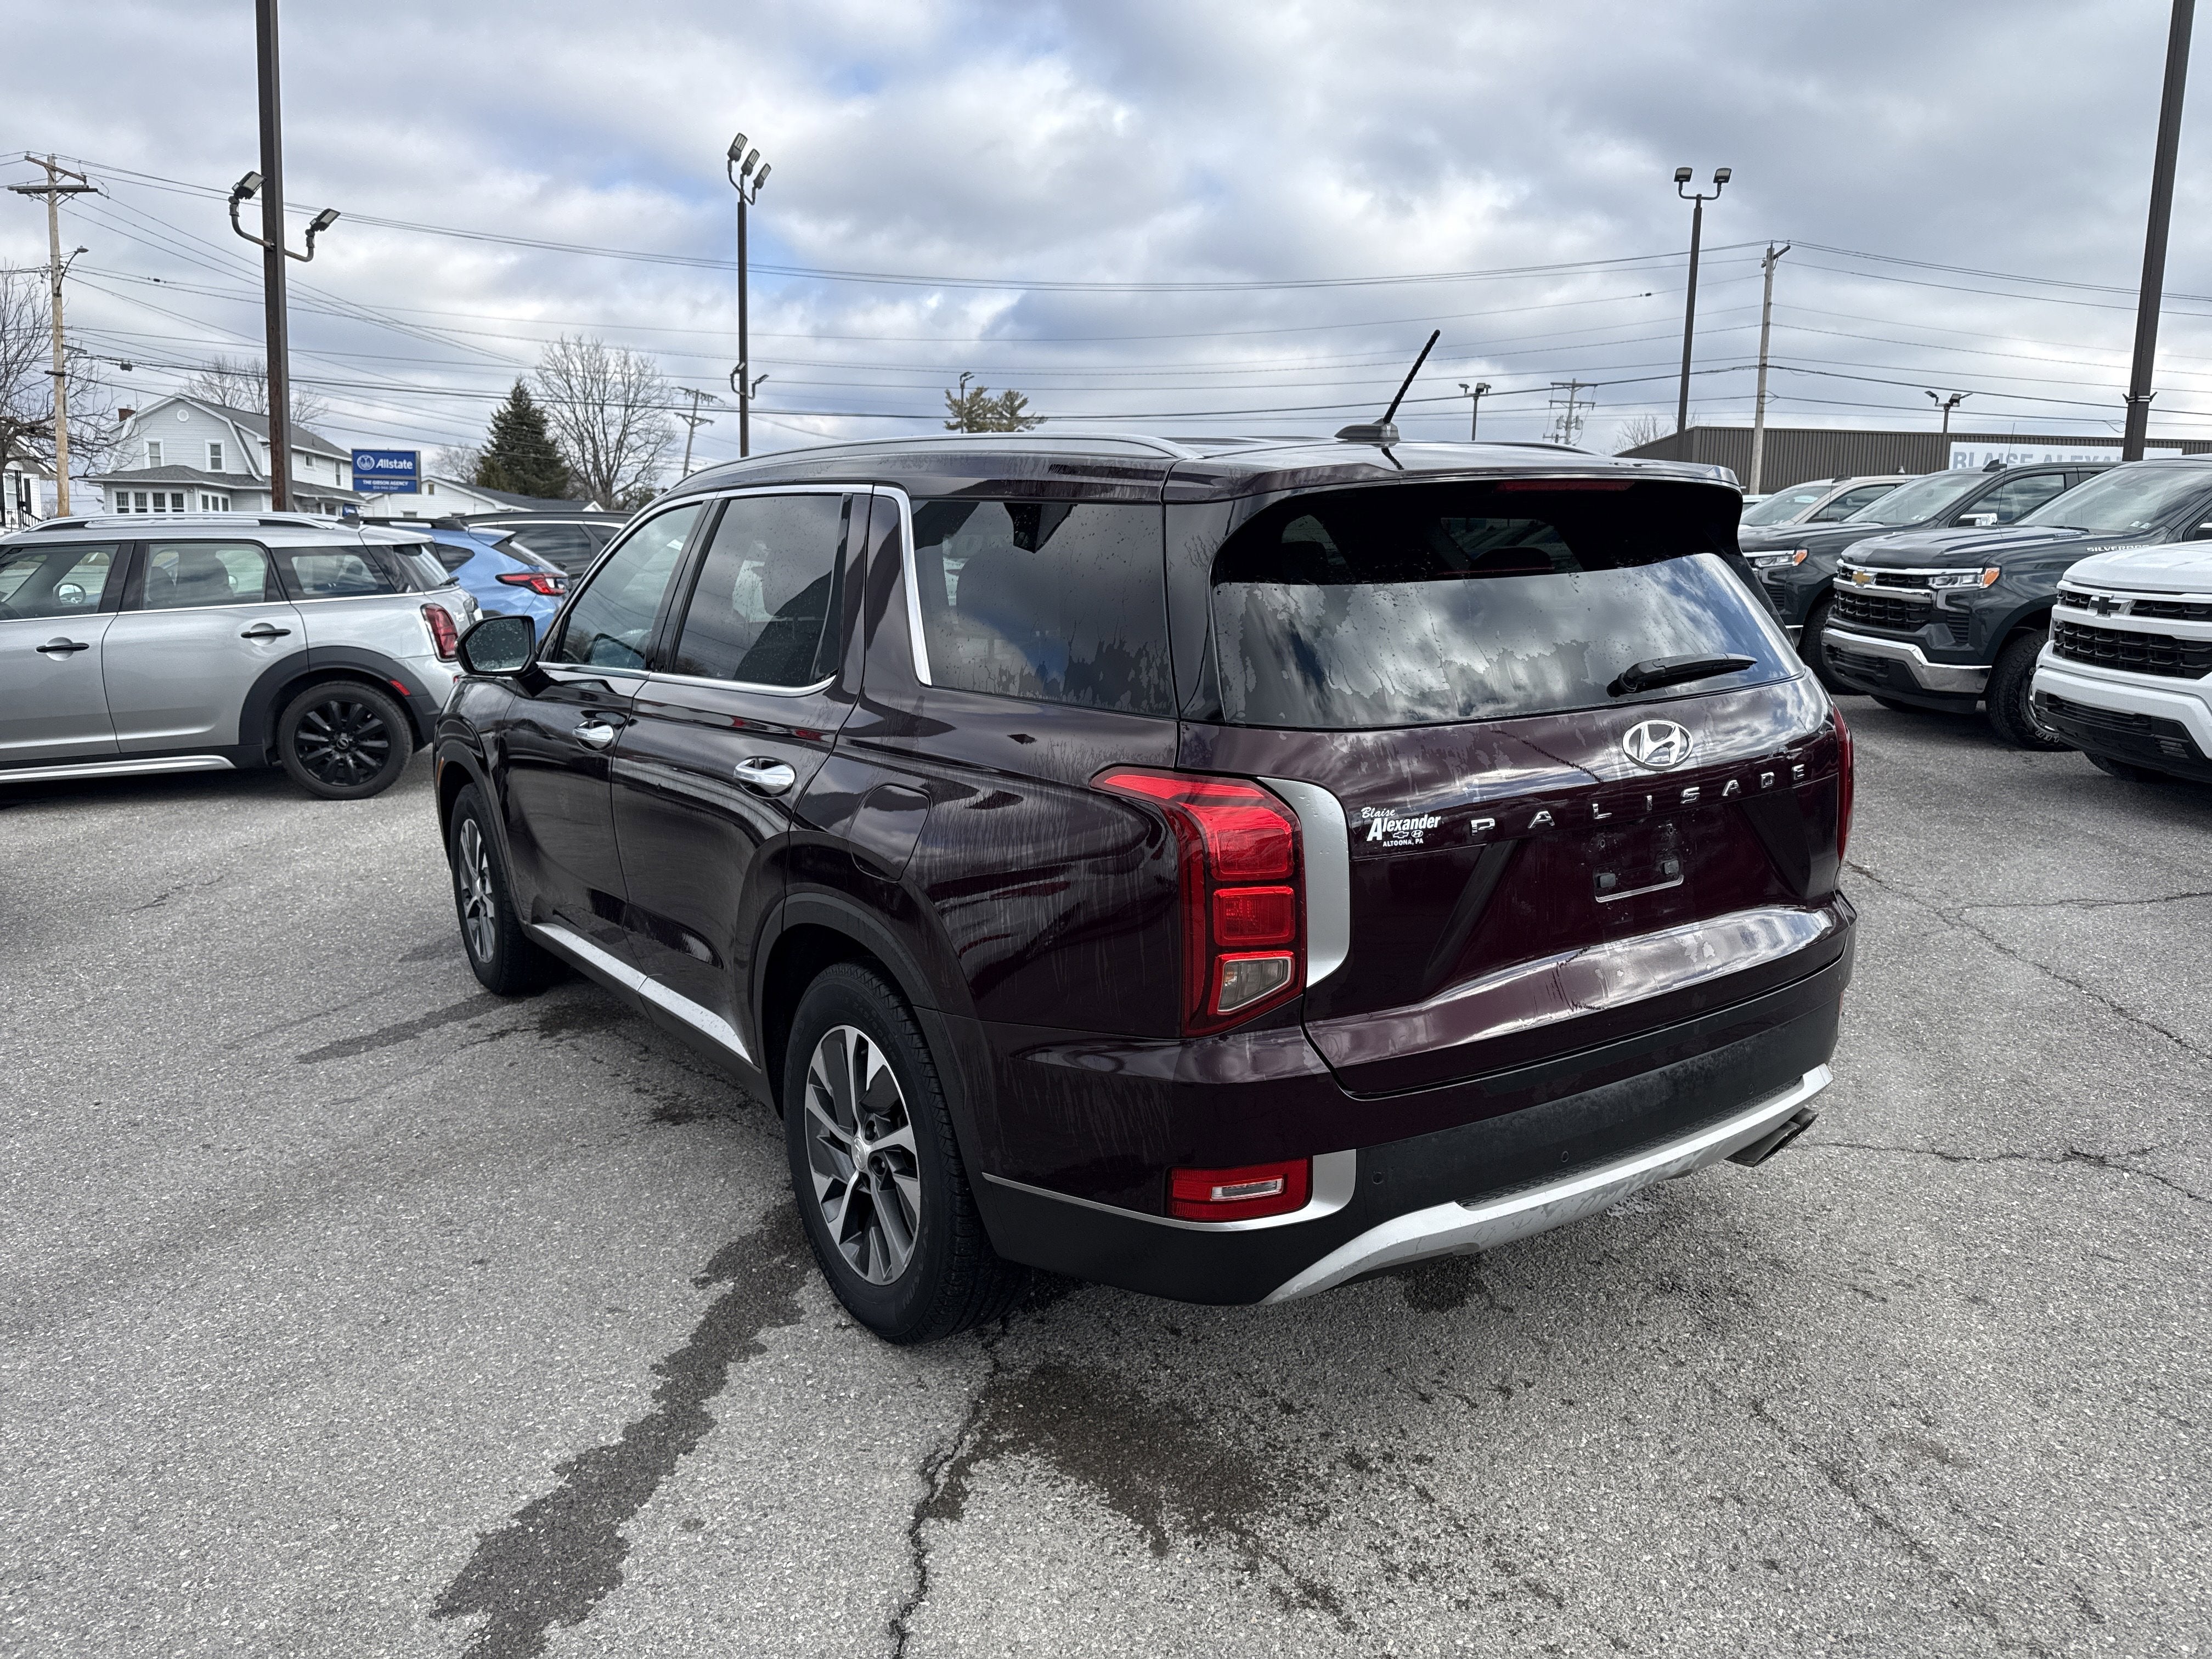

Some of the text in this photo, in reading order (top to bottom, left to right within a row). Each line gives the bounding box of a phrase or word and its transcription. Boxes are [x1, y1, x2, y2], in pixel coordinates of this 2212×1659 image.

[376, 459, 413, 470] Allstate
[1470, 764, 1805, 836] PALISADE
[1361, 807, 1395, 818] Blaise
[1367, 814, 1441, 841] Alexander
